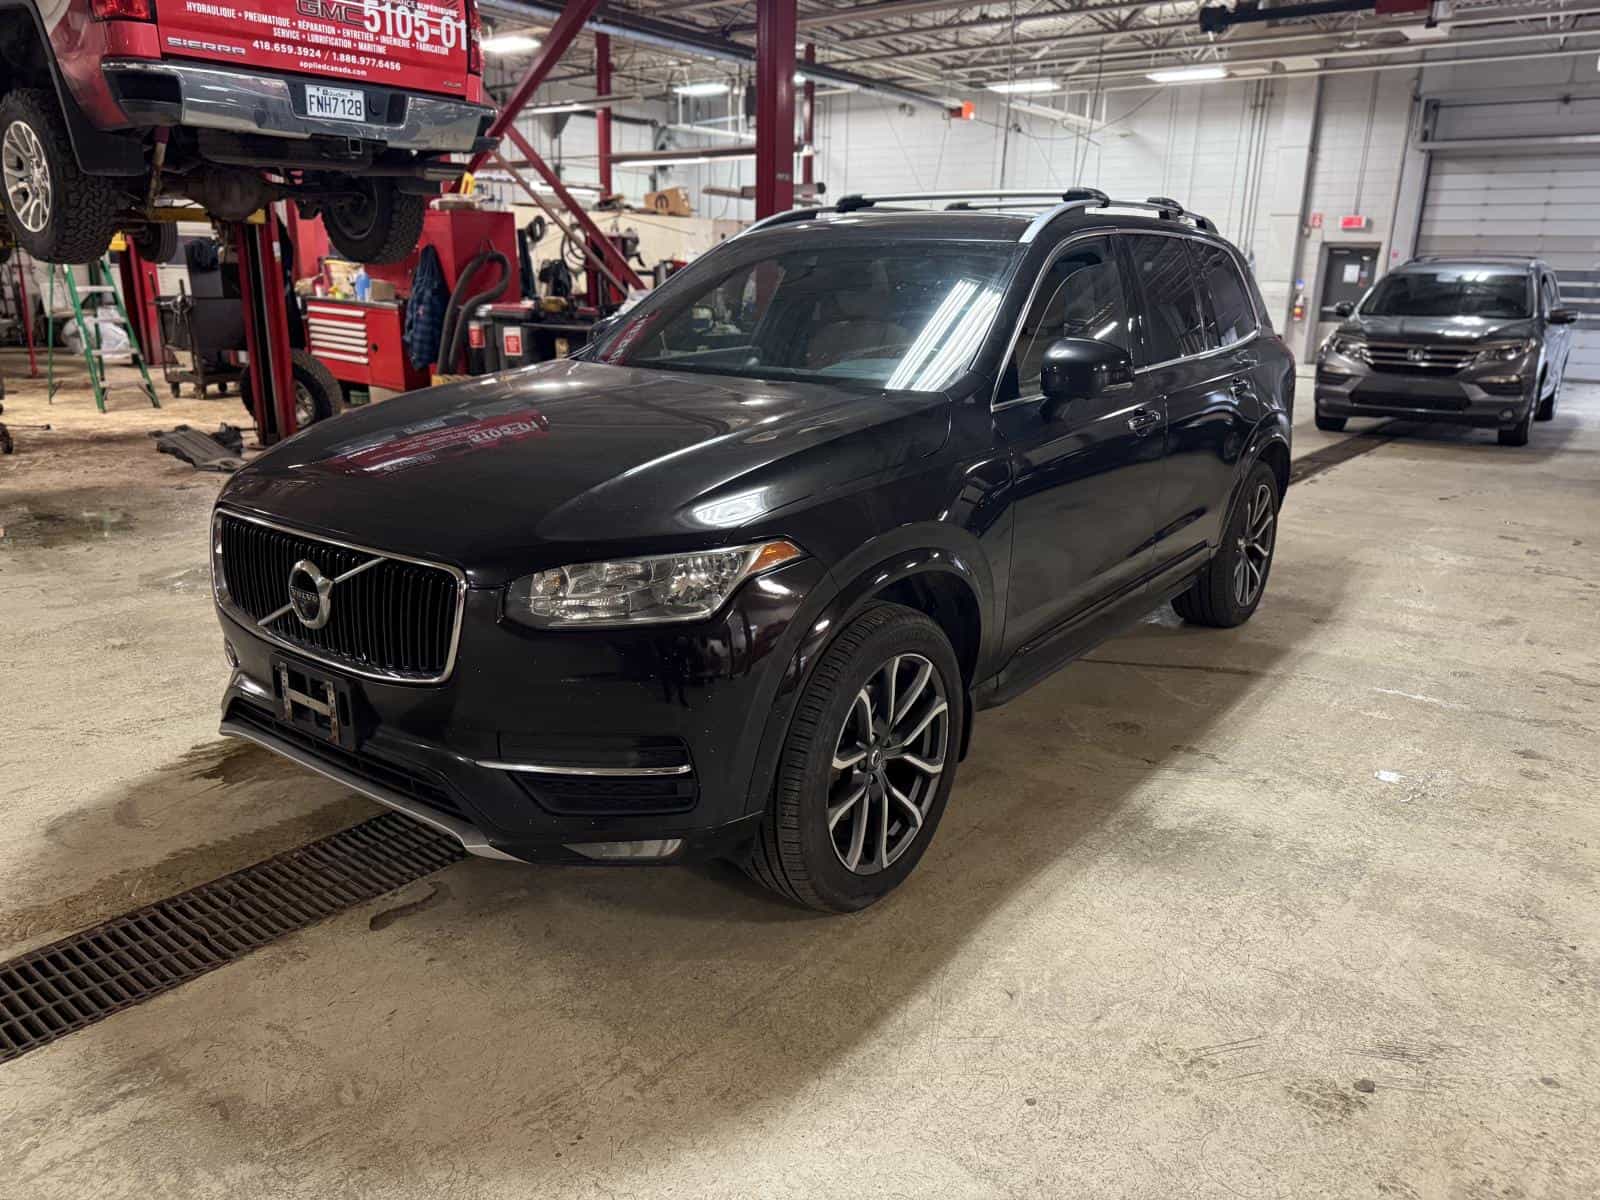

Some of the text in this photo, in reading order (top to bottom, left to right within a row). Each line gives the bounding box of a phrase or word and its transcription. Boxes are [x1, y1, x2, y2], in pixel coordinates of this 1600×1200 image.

[186, 1, 237, 19] HYDRAULIQUE
[244, 10, 290, 27] PNEUMATIQUE
[342, 28, 374, 41] ENTRETIEN
[296, 0, 366, 27] GMC
[363, 0, 467, 51] 5105-01
[167, 37, 246, 55] SIERRA
[273, 27, 300, 40] SERVICE
[307, 32, 352, 48] LUBRIFICATION
[252, 40, 322, 59] 418.659.3924
[299, 60, 368, 77] appliedcanada.com
[309, 94, 362, 117] FNH7128
